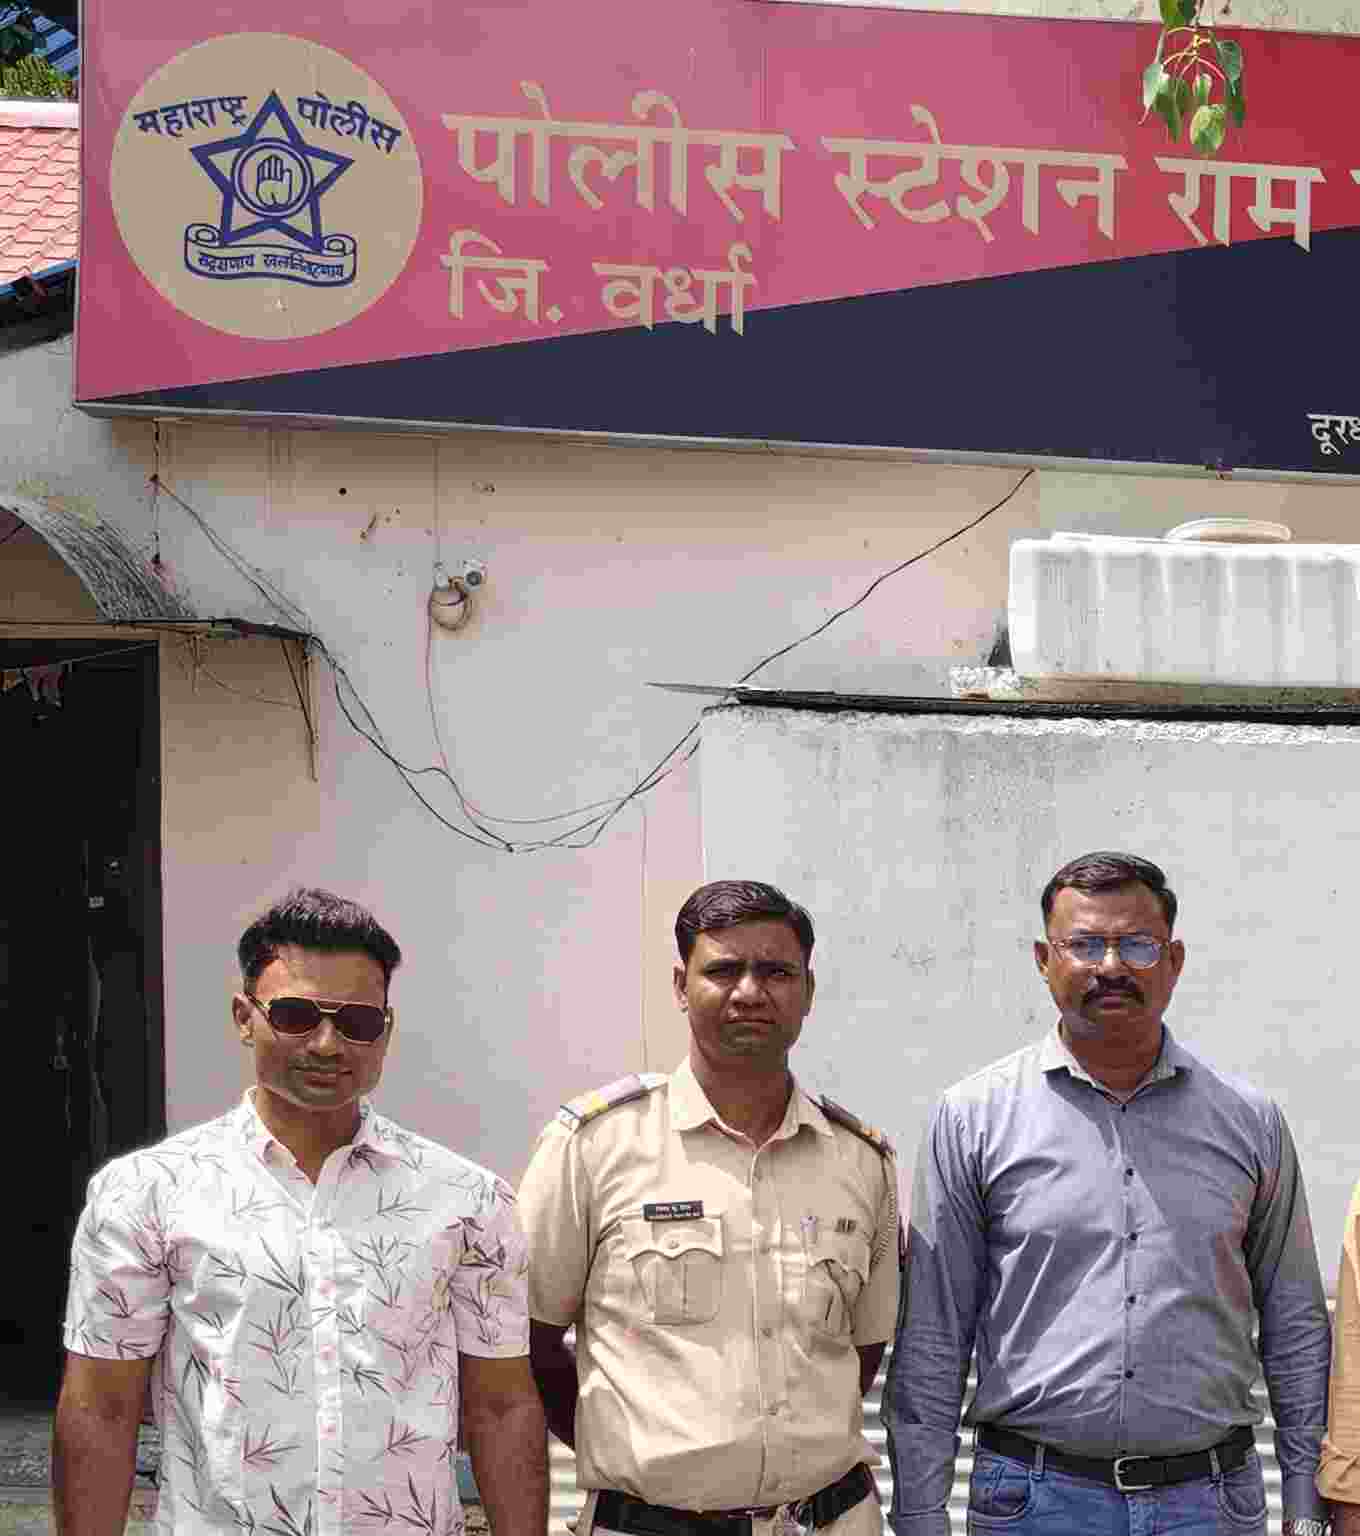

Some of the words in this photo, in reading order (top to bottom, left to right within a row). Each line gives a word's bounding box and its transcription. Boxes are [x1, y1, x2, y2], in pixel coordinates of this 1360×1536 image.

[133, 96, 248, 138] महाराष्ट्र
[297, 91, 402, 154] पोलीस
[440, 80, 797, 224] पोलीस
[820, 103, 1128, 243] स्टेशन
[1154, 155, 1326, 253] राम
[440, 229, 566, 325] जि.
[591, 241, 757, 337] वर्धा
